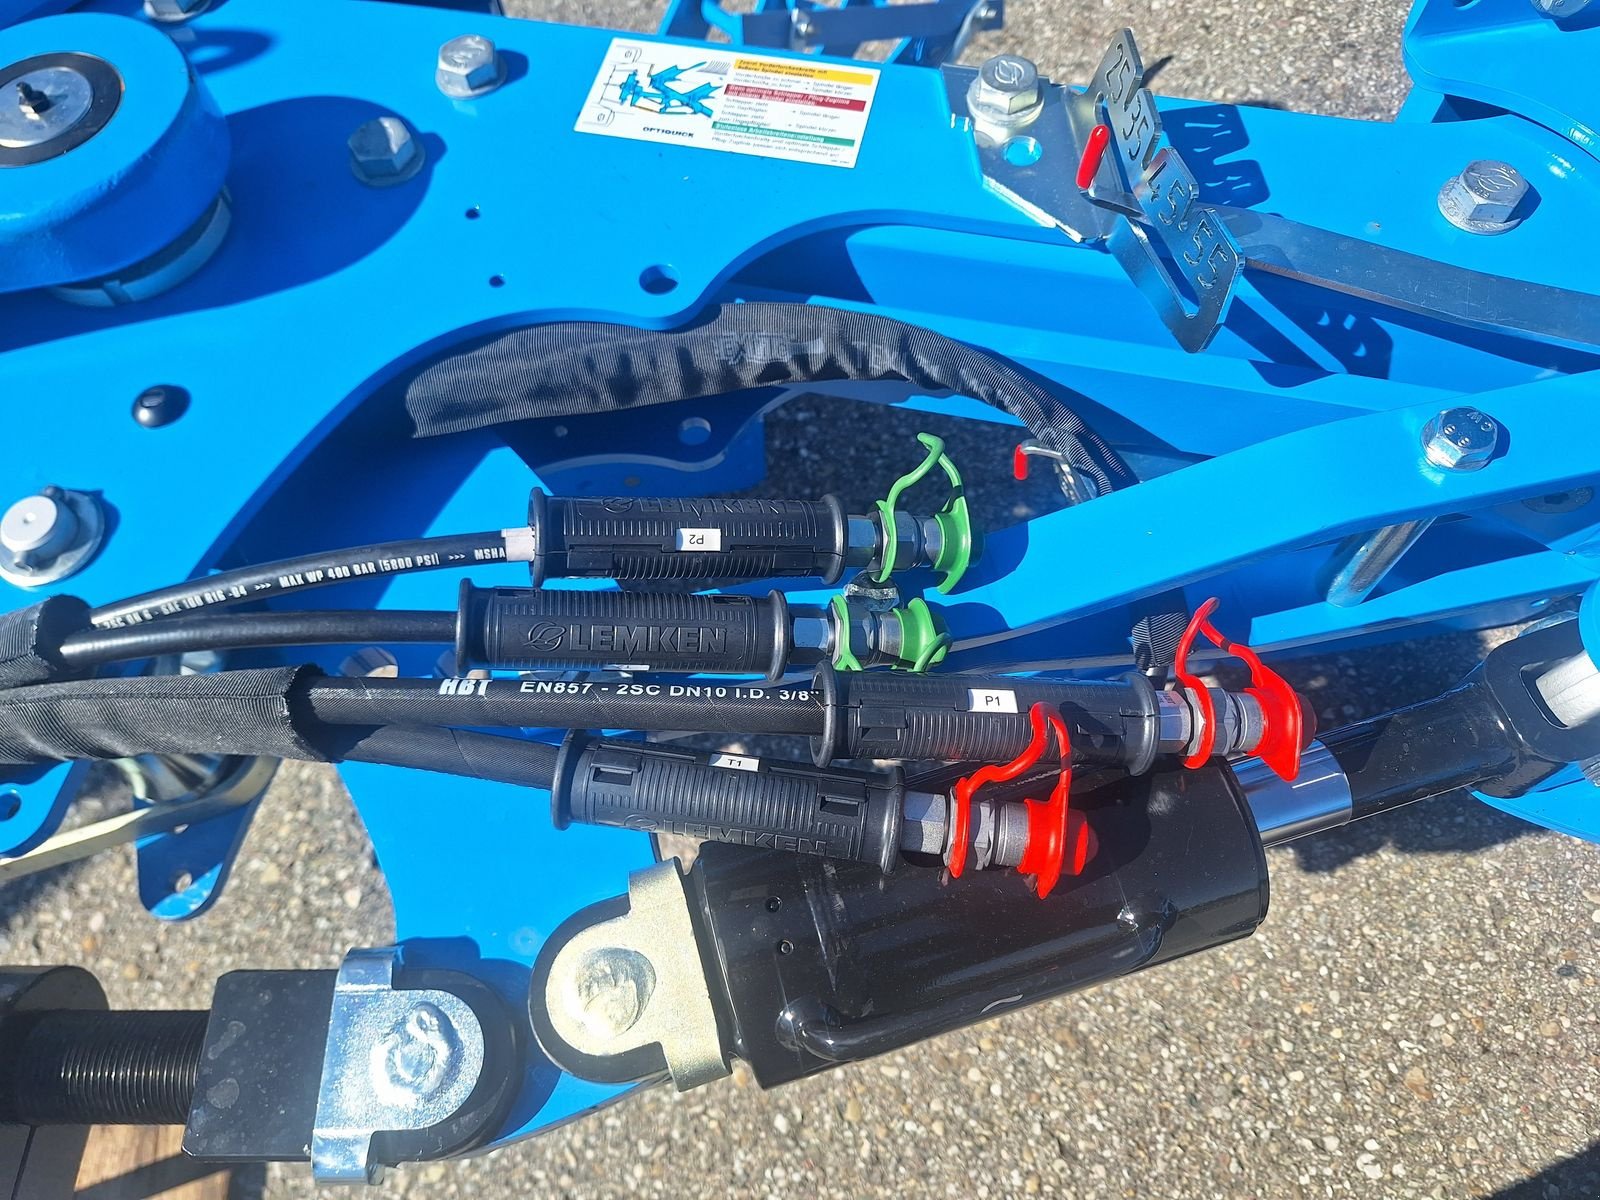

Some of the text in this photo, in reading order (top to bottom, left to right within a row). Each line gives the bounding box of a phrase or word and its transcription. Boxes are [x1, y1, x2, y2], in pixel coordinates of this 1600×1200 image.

[689, 534, 704, 545] P2
[278, 574, 304, 589] MAX
[305, 570, 324, 584] WP
[327, 565, 351, 580] 400
[353, 561, 377, 576] BAR
[474, 546, 506, 561] MSHA
[569, 623, 728, 658] LEMKEN
[438, 678, 493, 696] HBT
[519, 681, 594, 695] EN857
[616, 683, 661, 696] 2SC
[669, 685, 727, 698] DN10
[735, 688, 771, 700] I.D.
[985, 695, 1000, 707] P1
[727, 758, 743, 767] T1
